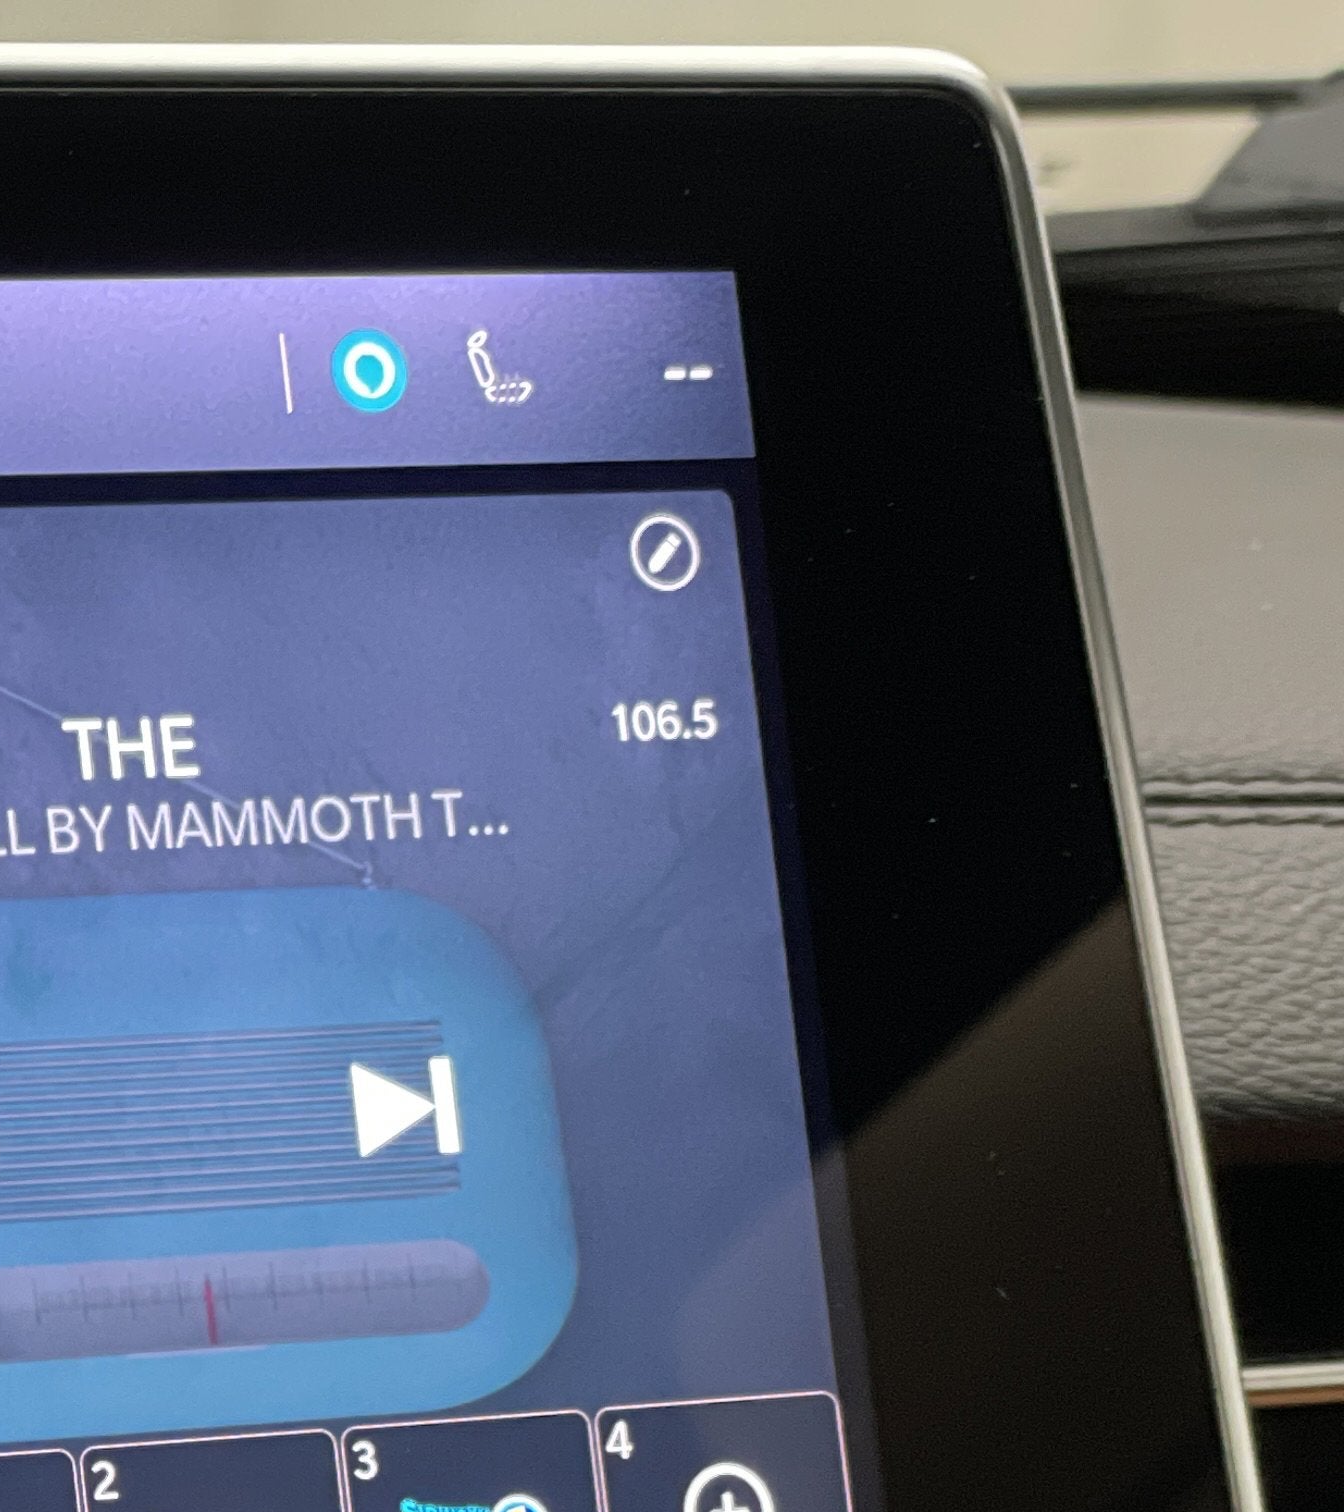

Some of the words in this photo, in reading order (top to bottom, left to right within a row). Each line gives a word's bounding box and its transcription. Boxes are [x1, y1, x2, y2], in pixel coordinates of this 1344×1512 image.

[611, 698, 719, 745] 106.5
[61, 714, 200, 782] THE
[49, 807, 116, 853] BY
[127, 799, 422, 850] MAMMOTH
[351, 1441, 380, 1481] 3
[605, 1419, 634, 1460] 4
[90, 1460, 120, 1502] 2
